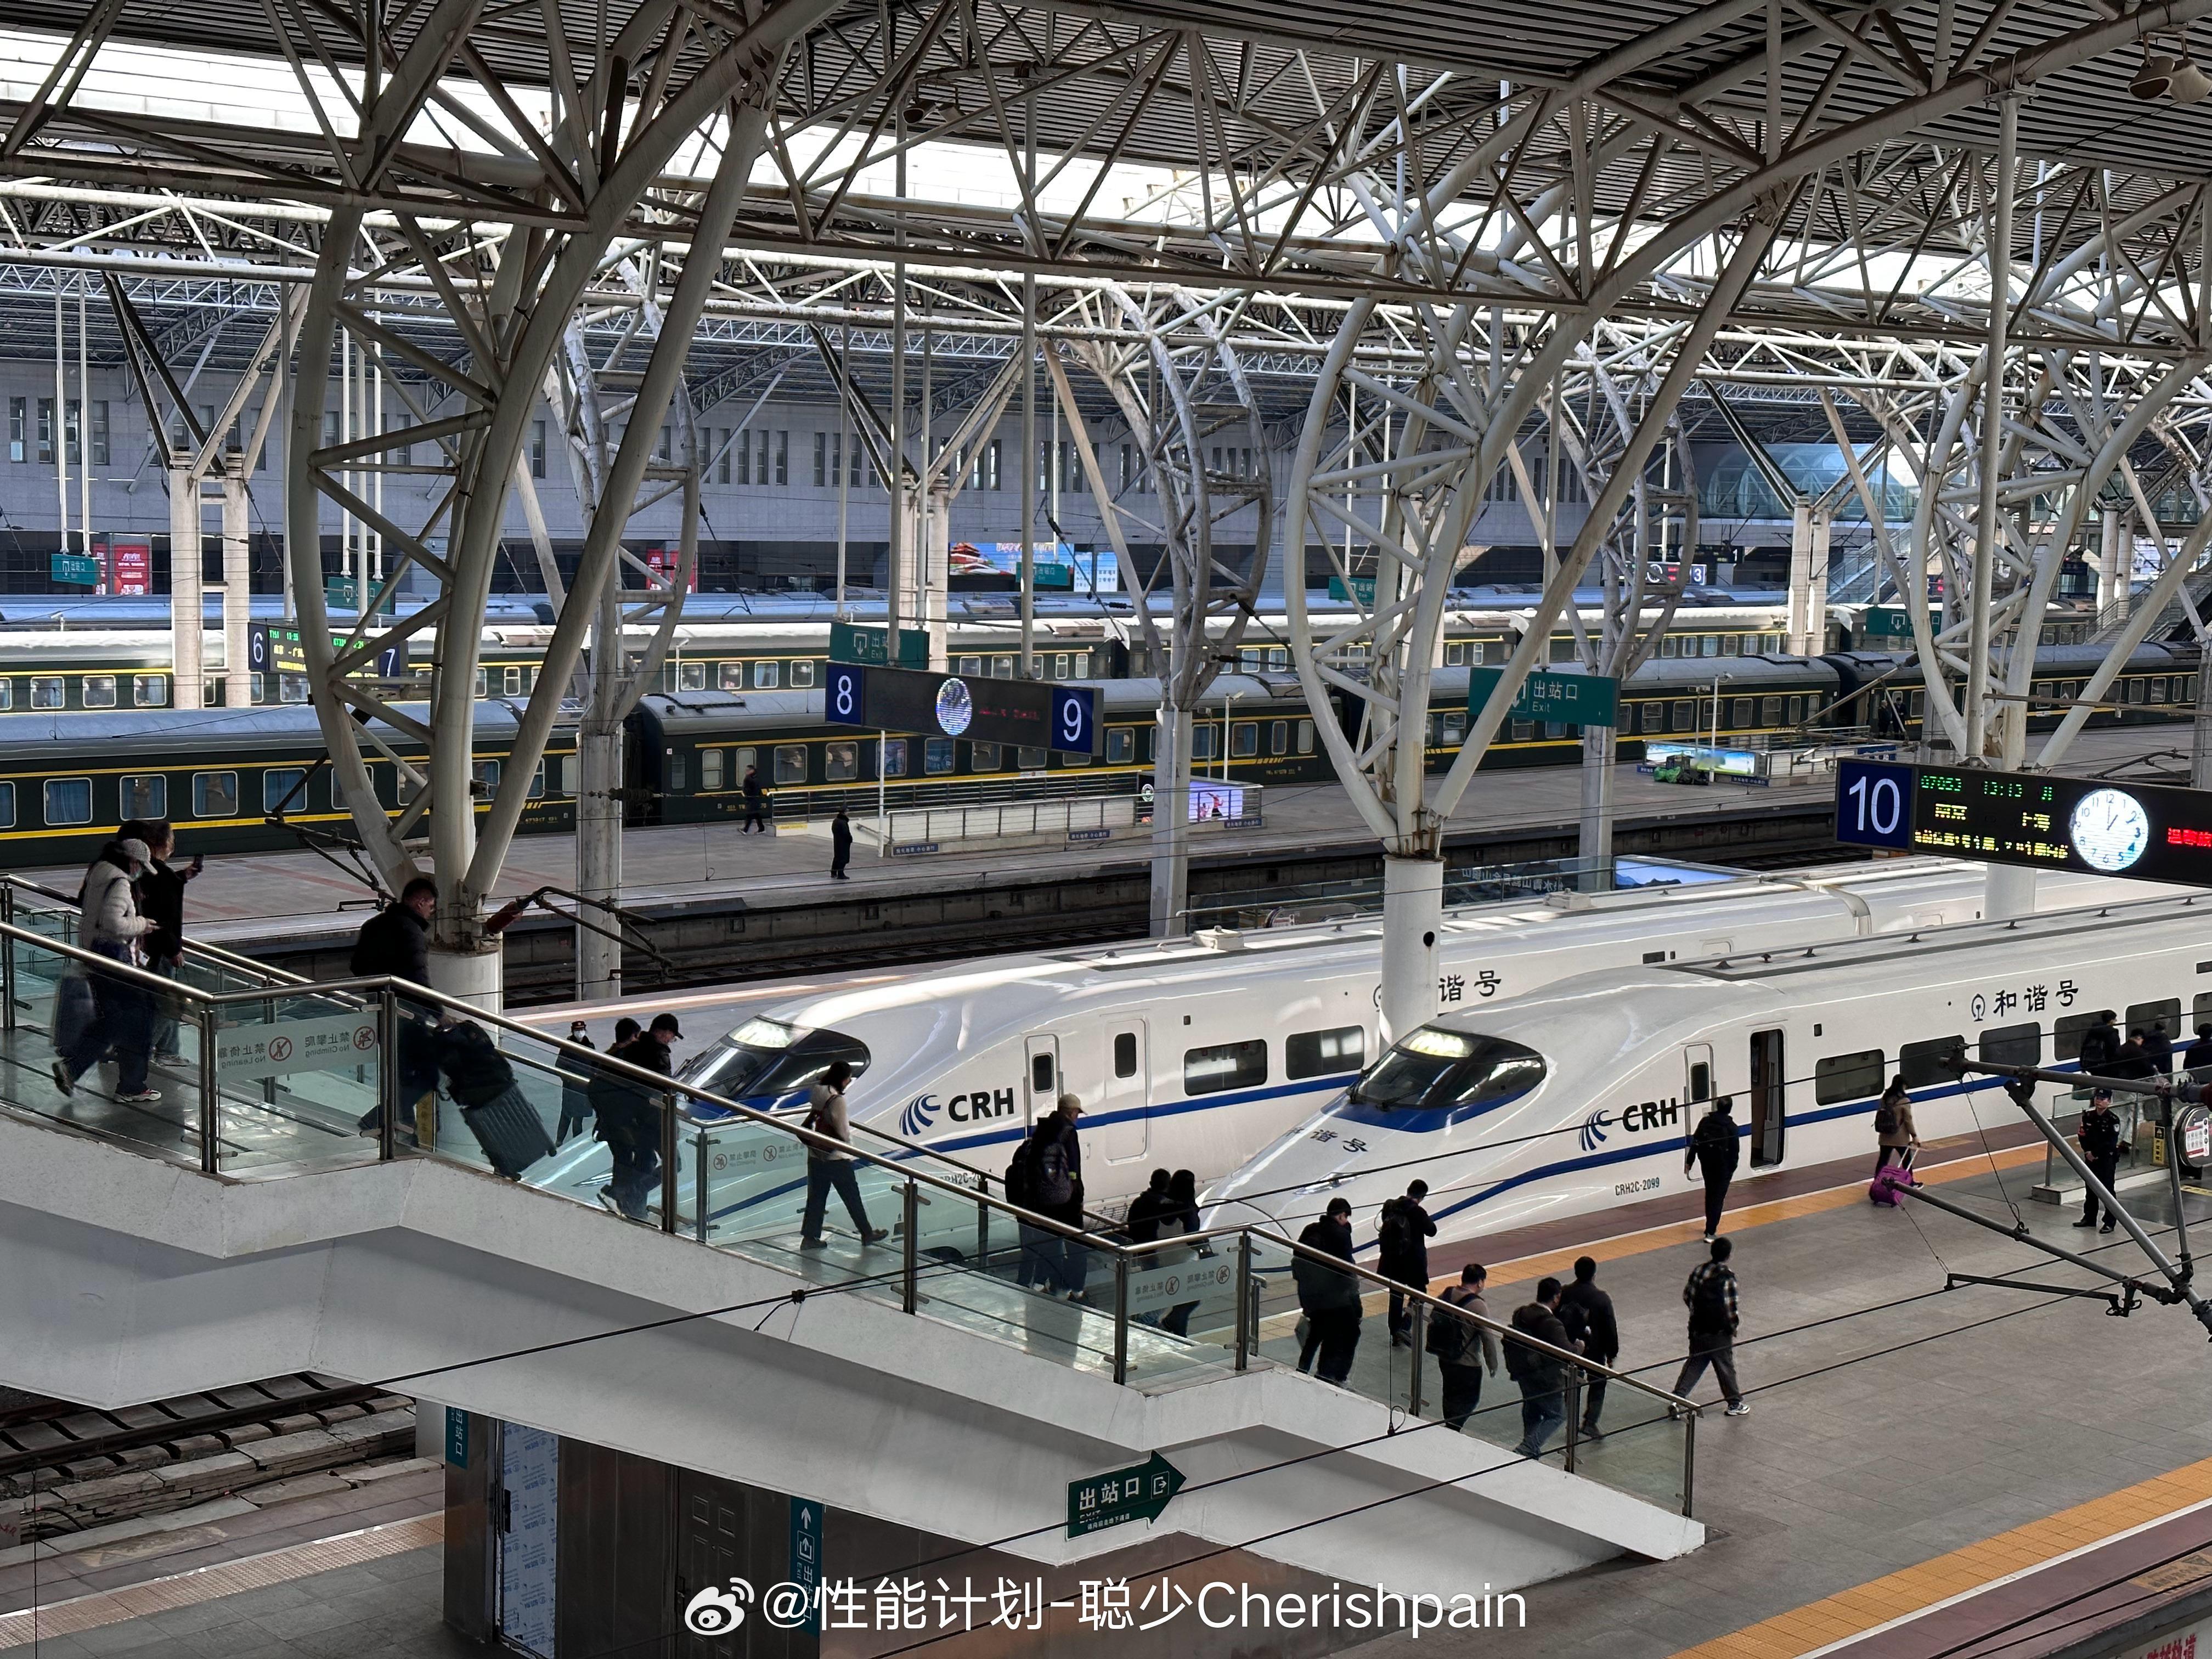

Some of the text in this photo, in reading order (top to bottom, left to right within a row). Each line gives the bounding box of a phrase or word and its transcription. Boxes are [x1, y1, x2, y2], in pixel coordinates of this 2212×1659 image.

[1694, 568, 1702, 582] 3
[1358, 583, 1376, 592] 出站
[253, 632, 263, 663] 6
[871, 633, 900, 650] 出站
[871, 650, 883, 659] Exit
[386, 648, 396, 677] 7
[837, 675, 853, 715] 8
[1533, 680, 1578, 701] 出站口
[1532, 701, 1550, 713] Exit
[1063, 698, 1082, 742] 9
[1849, 776, 1900, 834] 10
[2092, 797, 2099, 808] 11
[2106, 793, 2115, 804] 12
[2123, 799, 2126, 809] 1
[2081, 807, 2091, 817] 10
[2125, 810, 2138, 824] 2
[2134, 827, 2141, 838] 3
[2128, 842, 2136, 853] 4
[2103, 854, 2109, 863] 6
[2118, 852, 2124, 861] 5
[1438, 970, 1502, 1002] 谐号
[1993, 979, 2079, 1018] 和谐号
[949, 1088, 1014, 1122] CRH
[1622, 1098, 1678, 1132] CRH
[1615, 1177, 1660, 1196] CRH2C-2099
[1079, 1477, 1139, 1511] 出站口
